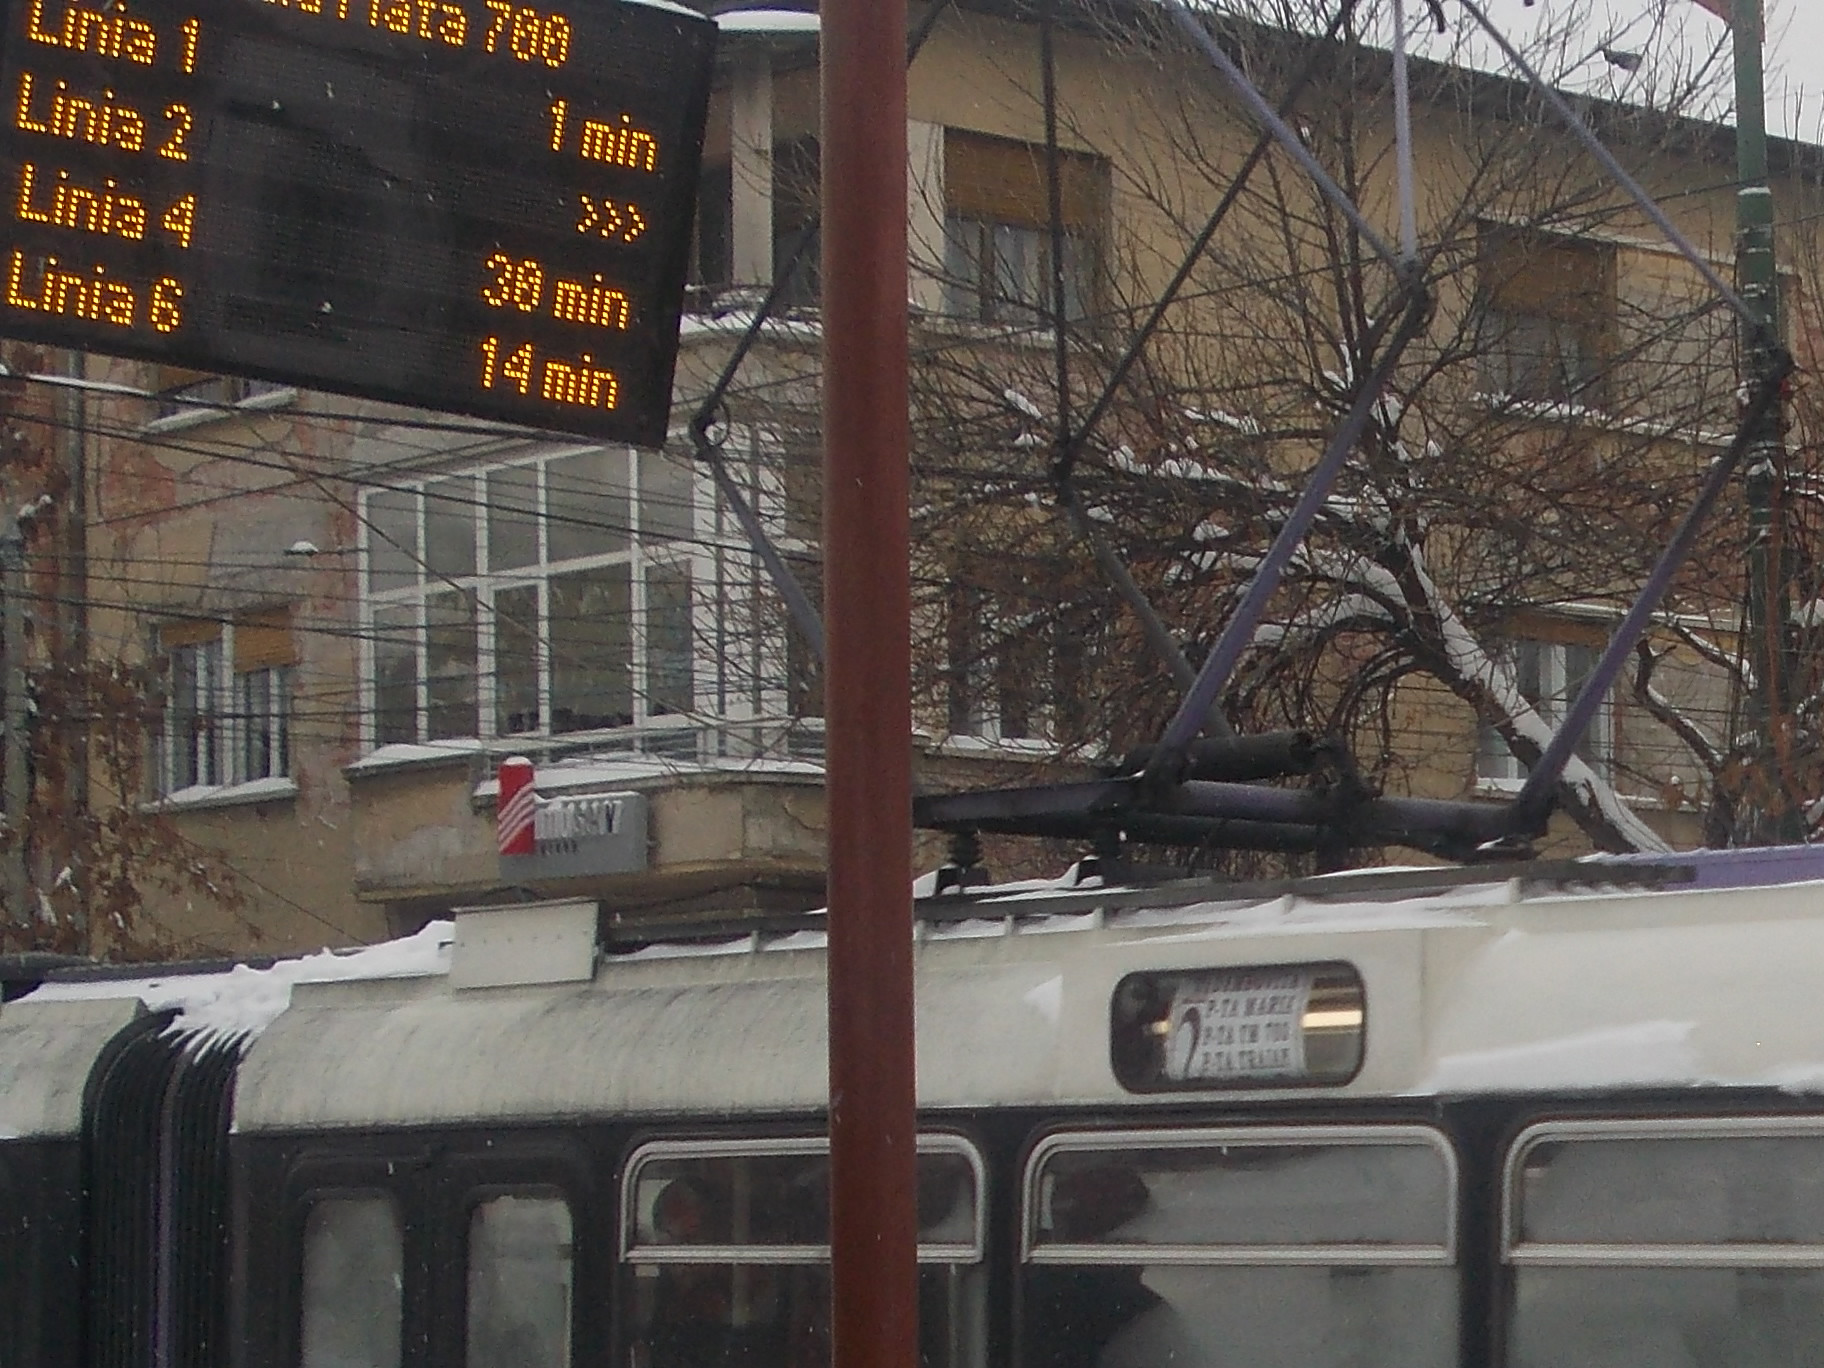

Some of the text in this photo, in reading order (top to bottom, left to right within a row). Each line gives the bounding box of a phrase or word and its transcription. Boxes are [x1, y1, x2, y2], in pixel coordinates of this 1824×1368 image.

[17, 72, 144, 152] Linia
[159, 103, 193, 161] 2
[30, 0, 657, 172] Linia 1 1 min
[19, 162, 146, 240] Linia
[163, 195, 195, 249] 4
[552, 272, 630, 330] min
[8, 250, 618, 410] Linia 6 14 min
